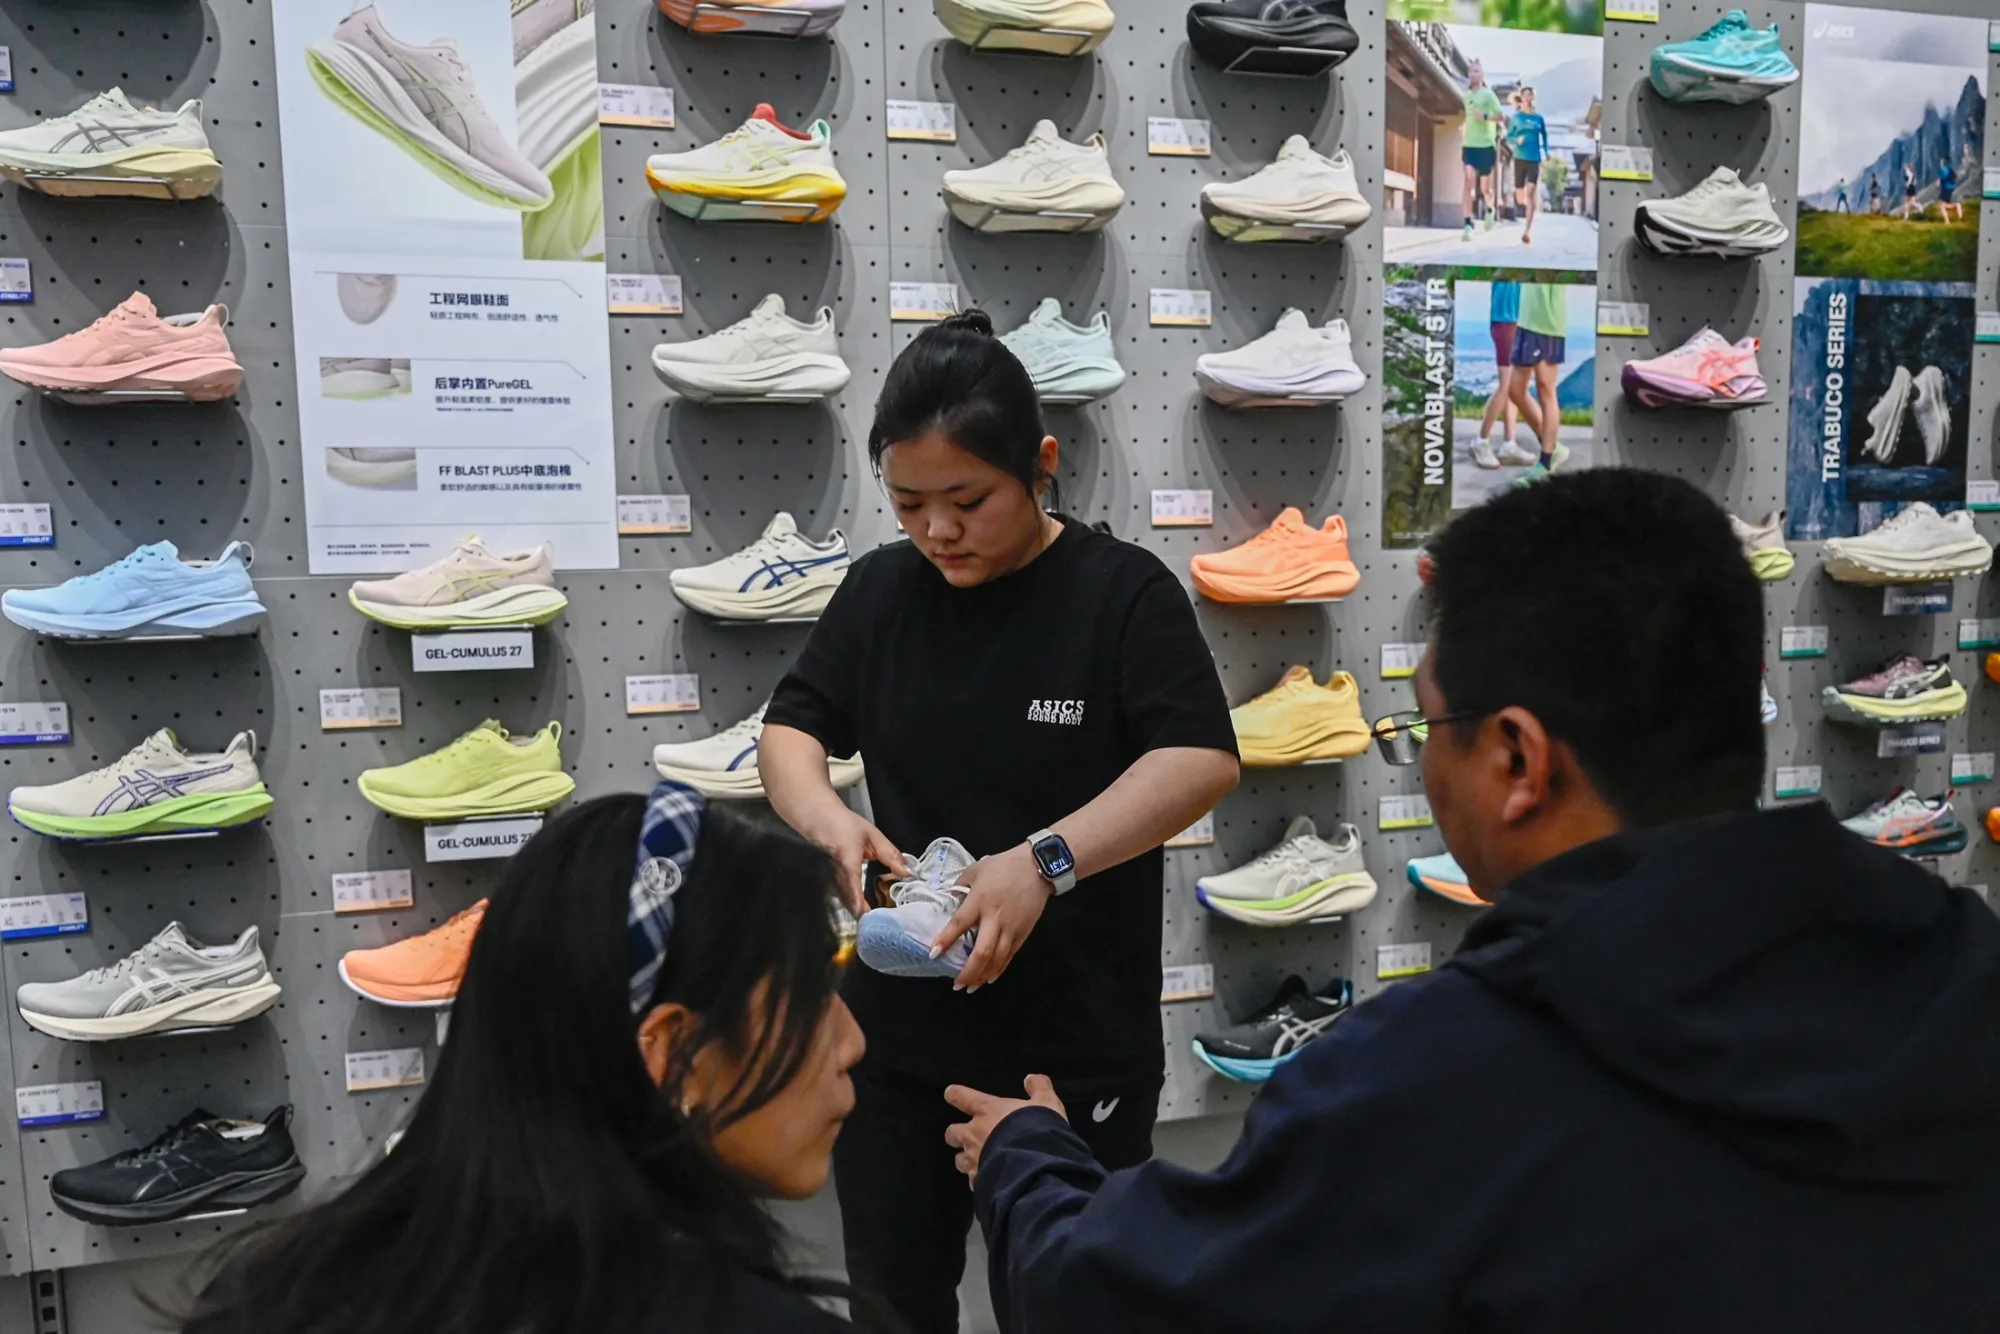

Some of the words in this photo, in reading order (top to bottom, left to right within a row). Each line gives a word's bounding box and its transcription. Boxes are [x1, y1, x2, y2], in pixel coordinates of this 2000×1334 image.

[429, 292, 509, 306] 工程网眼鞋面
[1426, 278, 1447, 310] TR
[1426, 315, 1446, 332] 5
[1827, 292, 1847, 369] SERIES
[435, 377, 533, 390] 后掌内置PureGEL
[1424, 337, 1446, 485] NOVABLAST
[1822, 372, 1844, 483] TRABUCO
[439, 465, 451, 476] FF
[454, 465, 490, 476] BLAST
[425, 646, 508, 660] GEL-CUMULUS
[509, 645, 523, 656] 27
[1030, 699, 1085, 715] ASICS
[437, 834, 519, 850] GEL-CUMULUS
